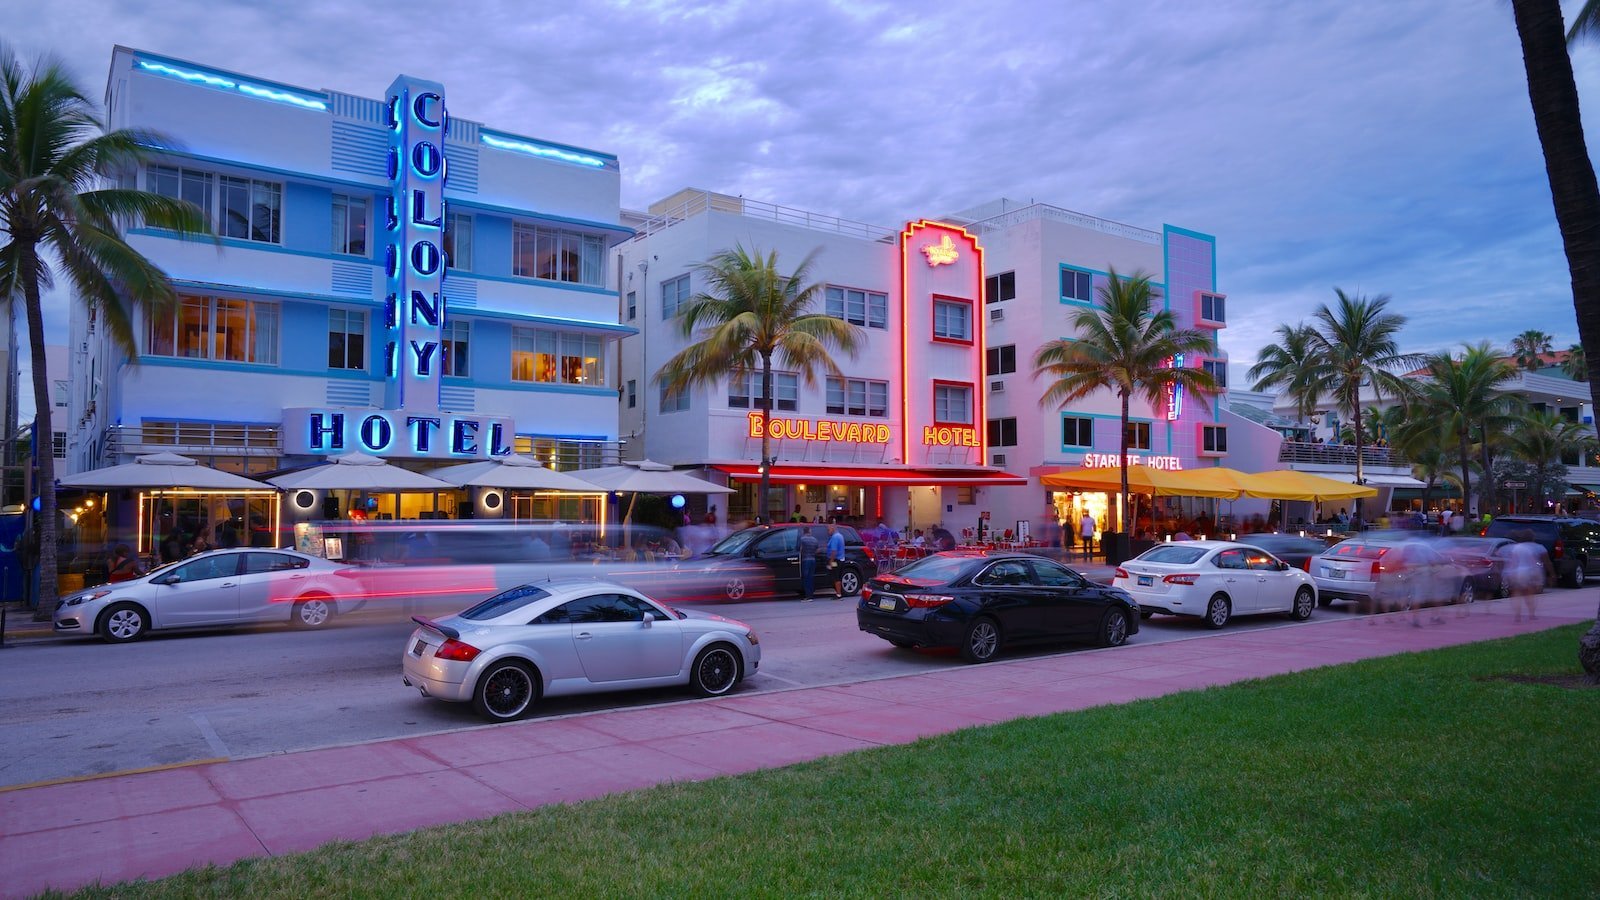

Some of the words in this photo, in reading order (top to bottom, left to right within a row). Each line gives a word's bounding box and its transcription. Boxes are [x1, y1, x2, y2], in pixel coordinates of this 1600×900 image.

[411, 92, 441, 376] COLONY
[1167, 354, 1177, 420] STRLITE
[310, 413, 510, 455] HOTEL
[748, 411, 890, 442] BOULEVARD
[924, 426, 980, 446] HOTEL
[1085, 453, 1140, 467] STARLTE
[1148, 456, 1182, 470] HOTEL
